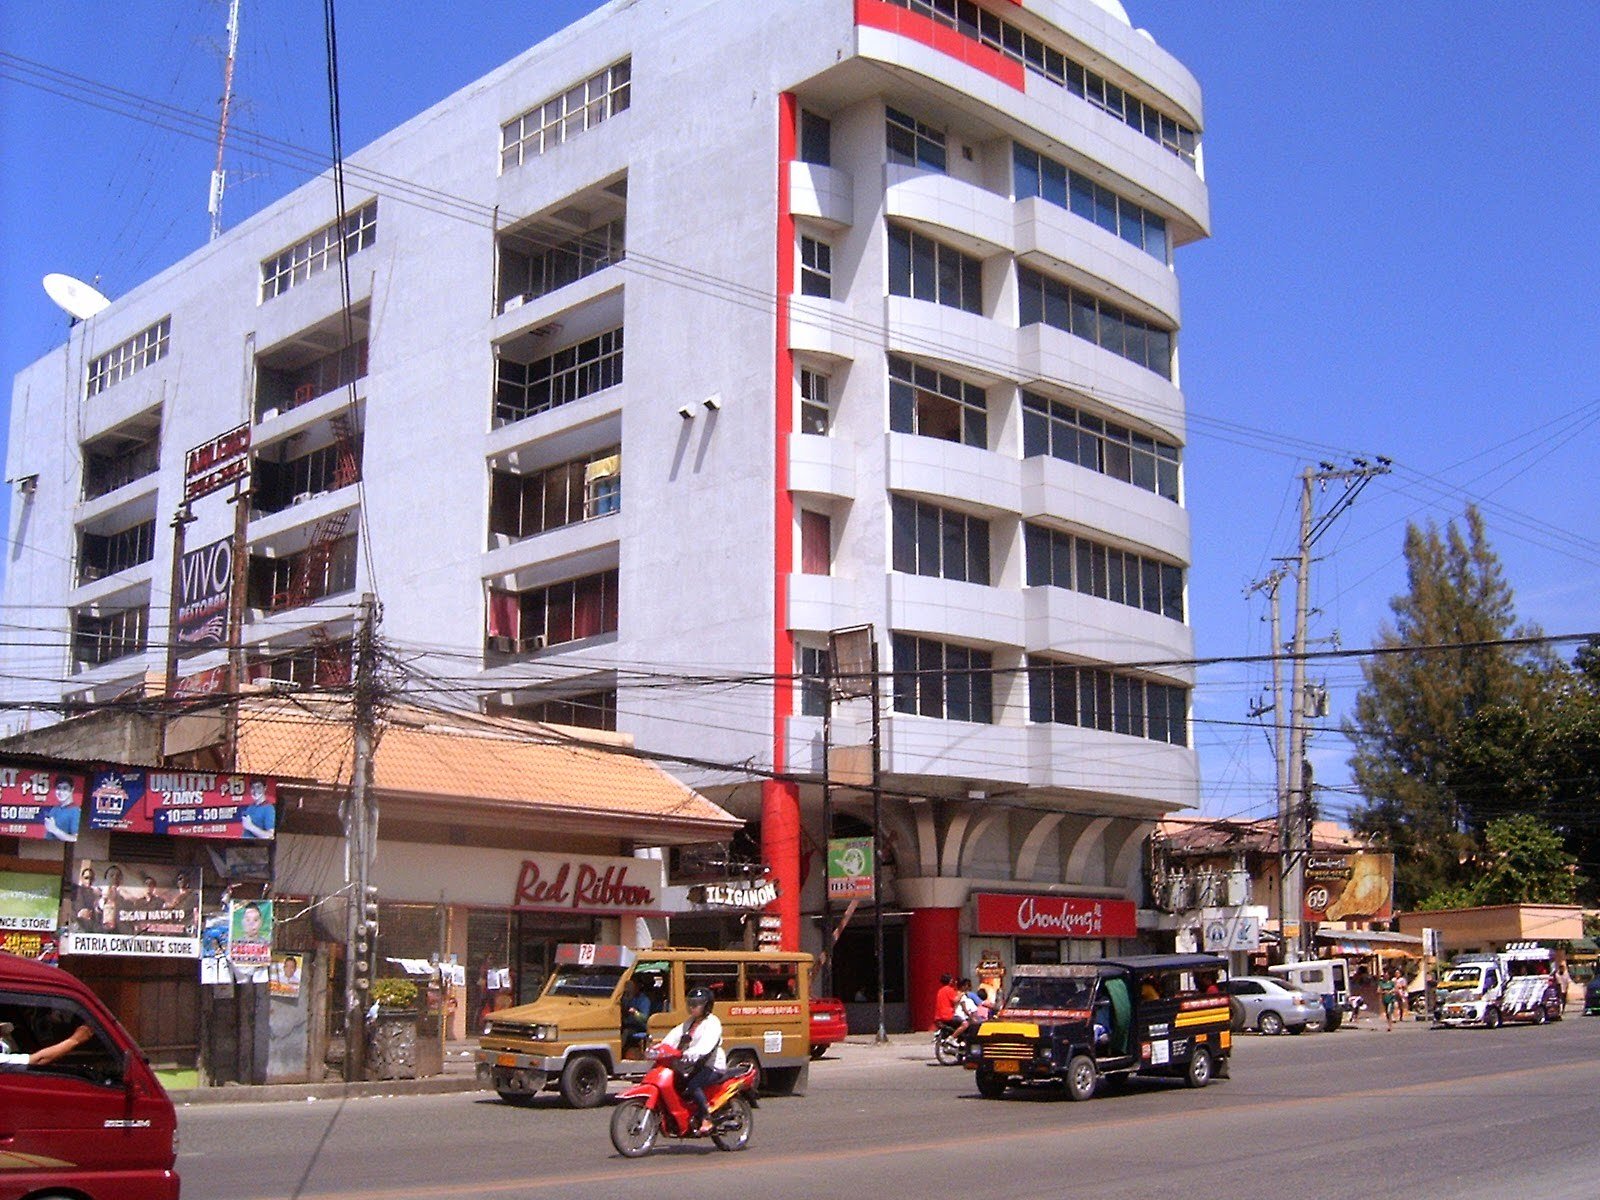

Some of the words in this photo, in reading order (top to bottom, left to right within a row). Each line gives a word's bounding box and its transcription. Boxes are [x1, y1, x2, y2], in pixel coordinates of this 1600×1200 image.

[182, 540, 230, 603] VIVO
[163, 791, 171, 805] 2
[172, 791, 203, 805] DAYS
[167, 810, 180, 823] 10
[203, 808, 218, 820] 50
[515, 860, 570, 907] Red
[572, 864, 655, 908] Ribbon
[1308, 889, 1328, 908] 69
[21, 918, 51, 929] STORE
[1018, 898, 1092, 934] Chowking
[75, 937, 108, 951] PATRIA
[110, 938, 165, 951] CONVINIENCE
[168, 943, 192, 954] STORE
